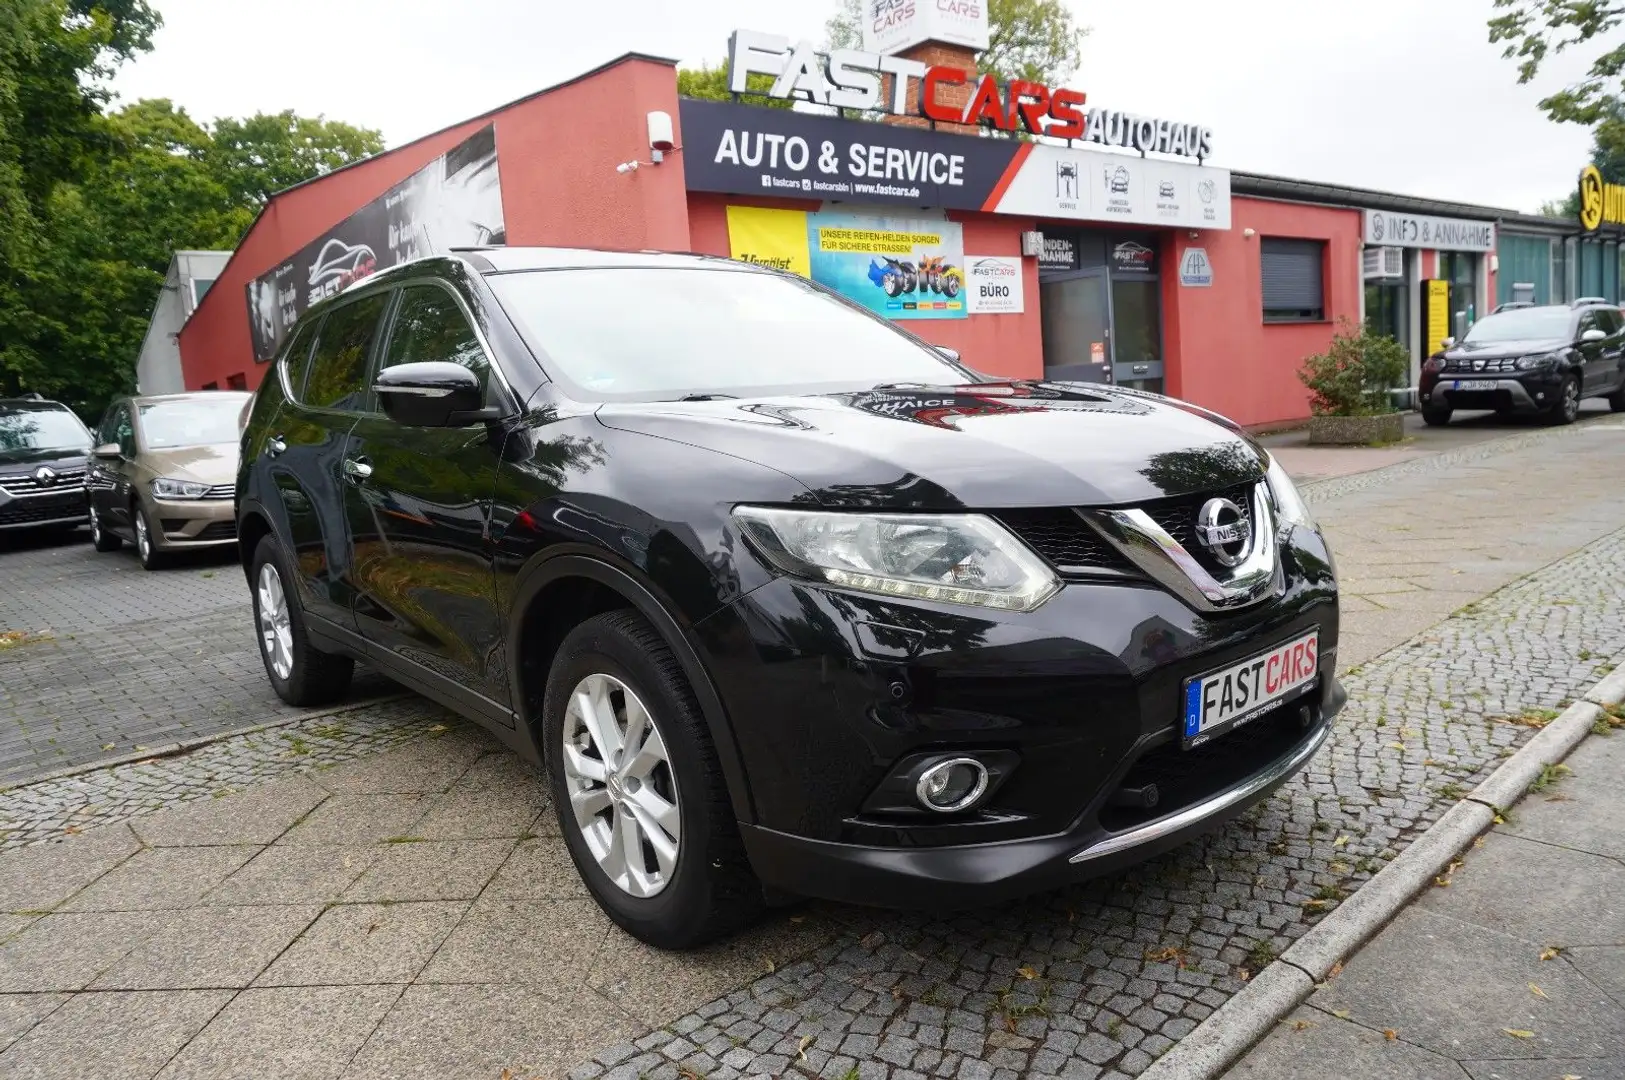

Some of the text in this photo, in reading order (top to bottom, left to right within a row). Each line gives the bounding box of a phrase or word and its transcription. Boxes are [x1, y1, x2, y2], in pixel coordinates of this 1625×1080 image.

[873, 2, 916, 34] CARS
[937, 0, 980, 19] CARS
[1083, 108, 1213, 160] AUTOHAUS
[714, 129, 965, 186] AUTO & SERVICE
[772, 176, 801, 189] fastcars
[855, 182, 920, 198] www.fastcars.de
[820, 229, 940, 244] UNSERE REIFEN-HELDEN SORGEN
[1389, 217, 1418, 241] INFO
[1434, 223, 1490, 247] ANNAHME
[821, 240, 837, 250] FÜR
[839, 241, 871, 252] SICHERE
[1043, 239, 1073, 250] NDEN-
[973, 267, 1016, 276] FASTCARS
[980, 282, 1009, 297] BÜRO
[1202, 637, 1316, 724] FASTCARS
